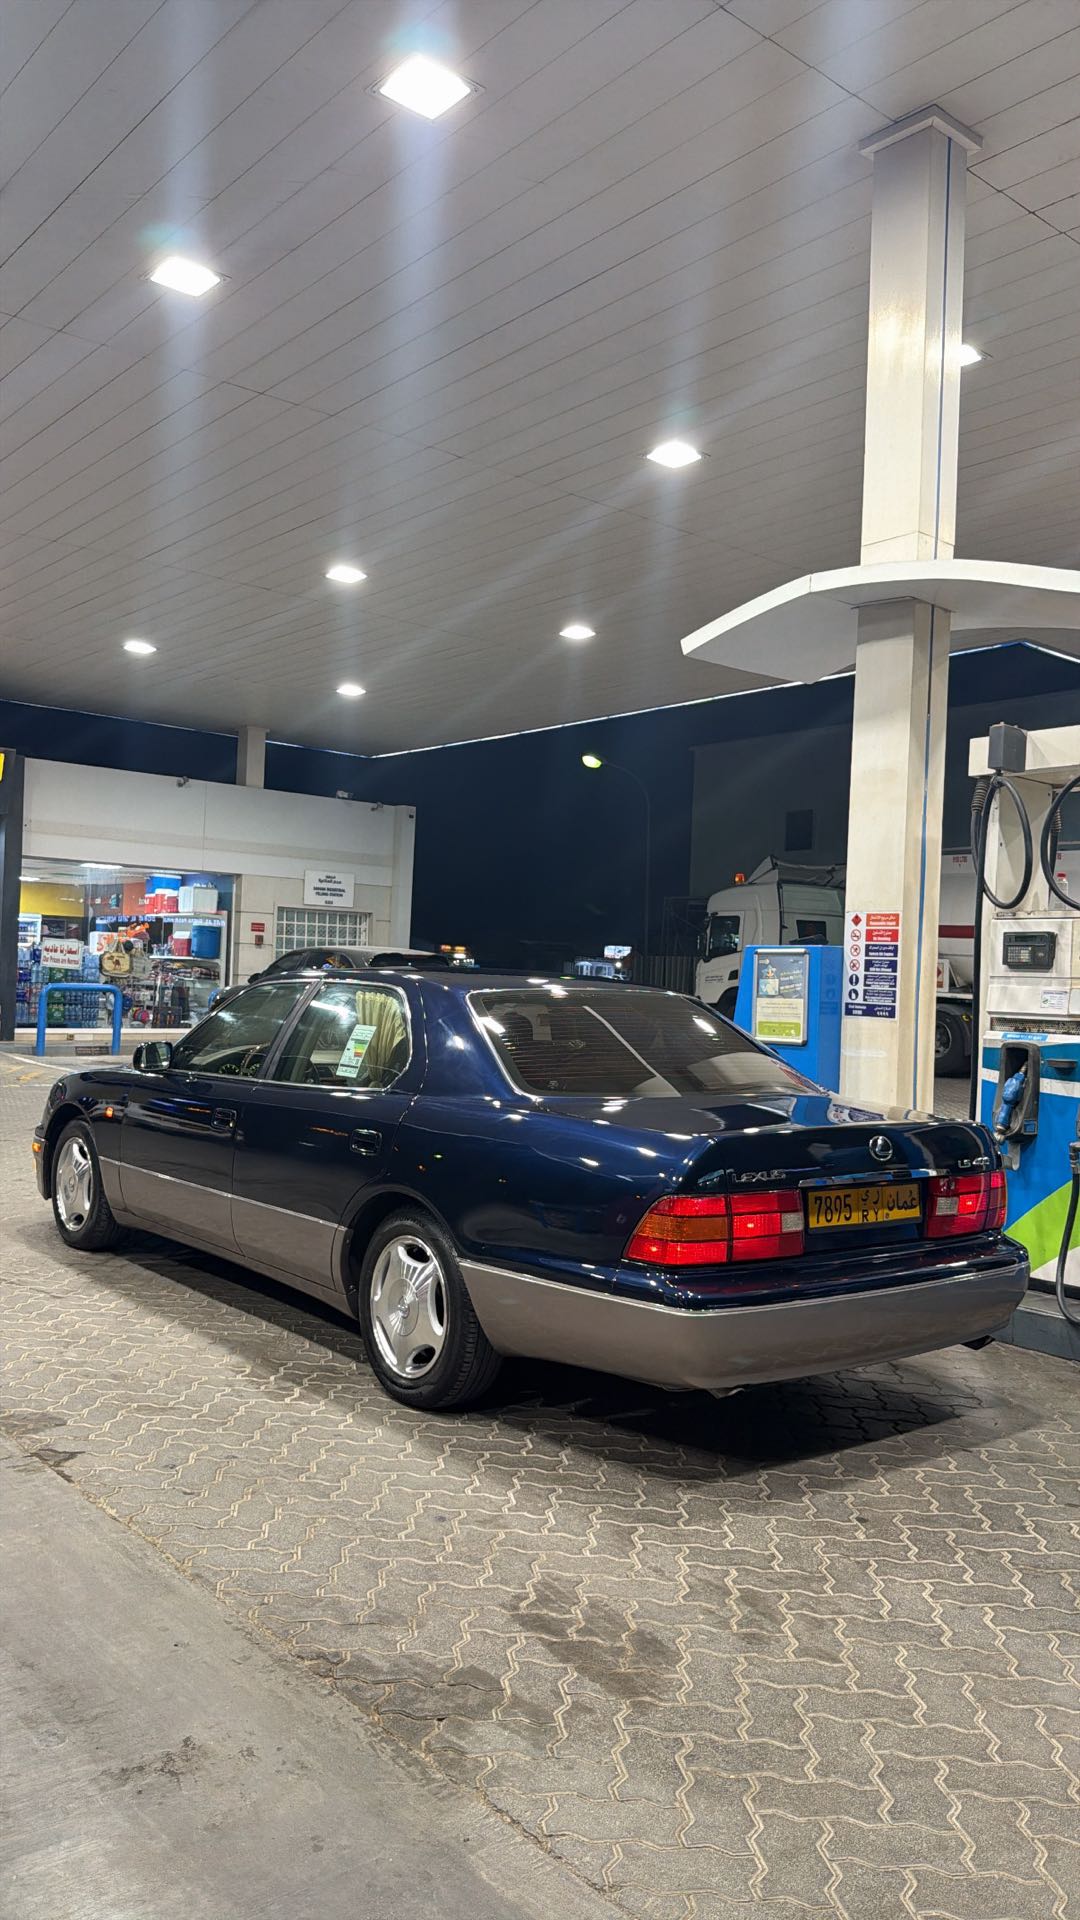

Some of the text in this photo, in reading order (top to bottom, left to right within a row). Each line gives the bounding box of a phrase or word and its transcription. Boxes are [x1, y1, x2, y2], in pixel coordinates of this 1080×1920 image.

[957, 1159, 971, 1168] LS
[731, 1169, 786, 1183] LEXUS
[814, 1193, 852, 1224] 7895
